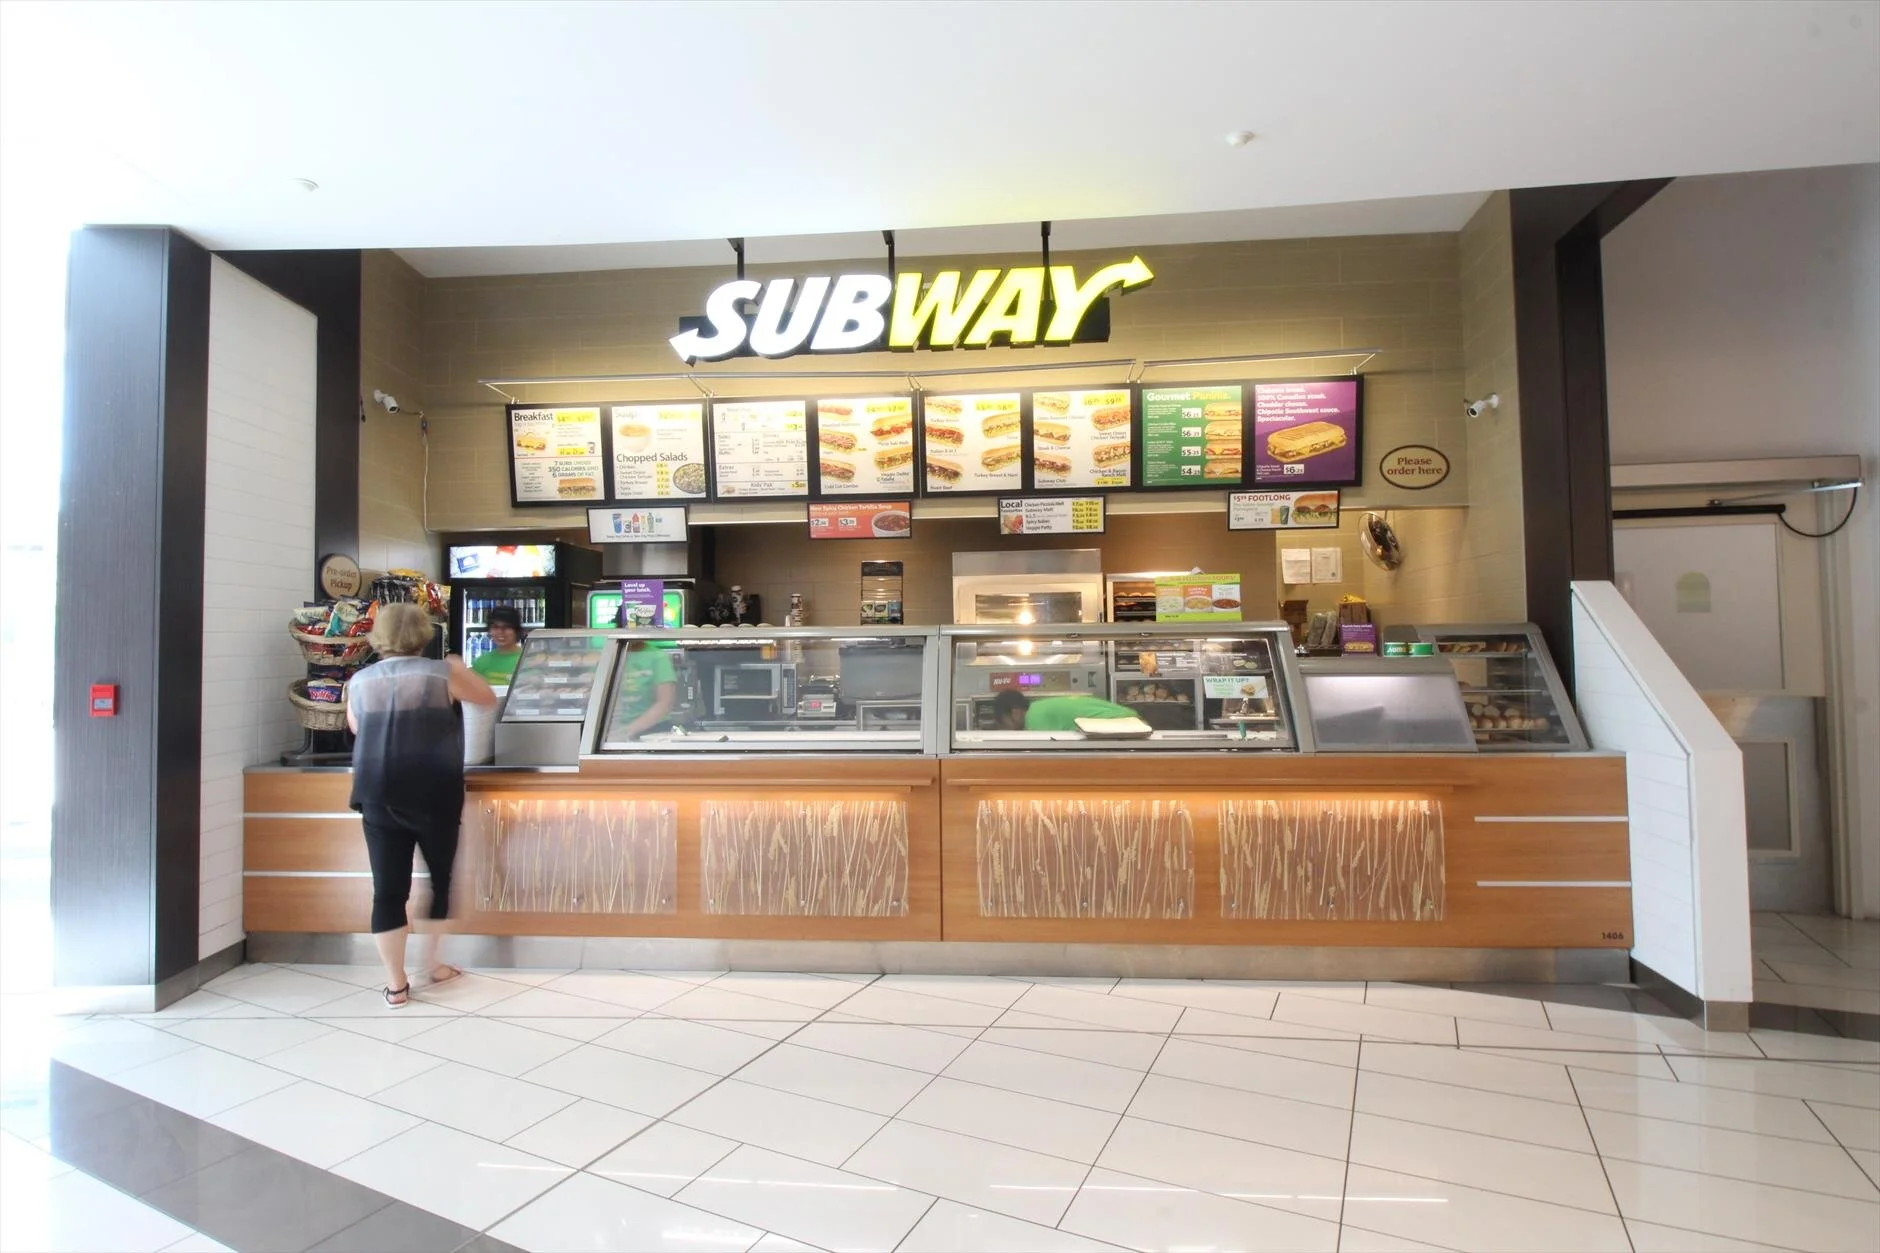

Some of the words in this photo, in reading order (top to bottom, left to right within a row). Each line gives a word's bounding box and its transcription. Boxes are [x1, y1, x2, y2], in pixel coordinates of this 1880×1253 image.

[668, 255, 1154, 366] SUBWAY
[1146, 392, 1191, 401] Gourmet
[514, 412, 553, 421] Breakfast
[616, 452, 657, 464] Chopped
[659, 452, 688, 461] Salads
[1397, 457, 1432, 465] Please
[1386, 467, 1416, 475] order
[1418, 466, 1442, 475] here
[1248, 494, 1291, 502] FOOTLONG
[330, 579, 353, 592] Pickup
[1601, 932, 1624, 940] 1406
